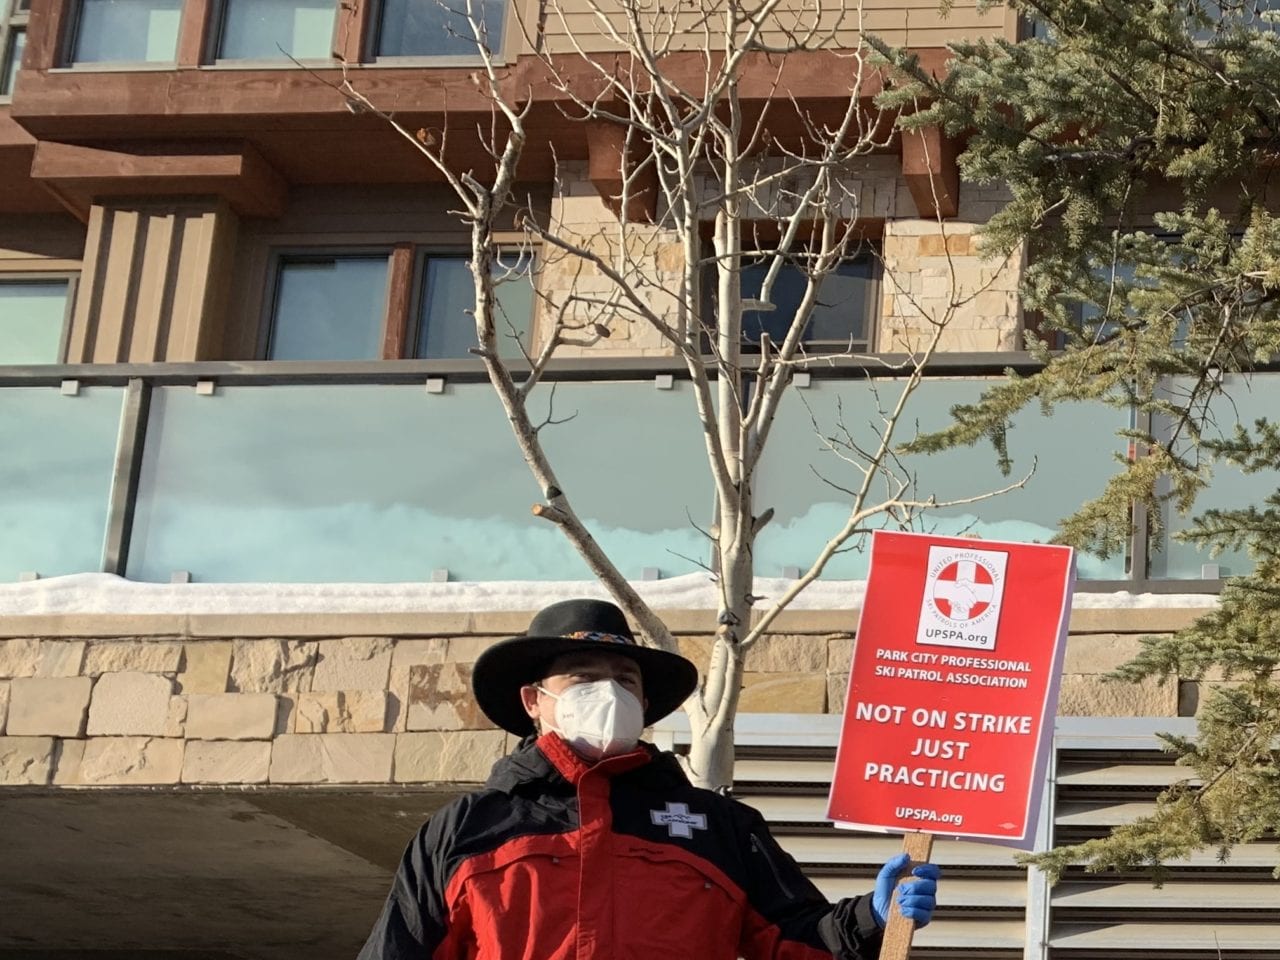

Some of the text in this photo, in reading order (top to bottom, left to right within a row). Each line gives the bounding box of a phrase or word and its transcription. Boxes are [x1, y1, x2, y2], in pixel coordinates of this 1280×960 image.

[930, 552, 1000, 581] UNITED PROFESSIONAL
[932, 610, 957, 628] PATROLS
[971, 604, 997, 626] AMERICA
[925, 629, 988, 645] UPSPA.org
[877, 649, 1031, 671] PARK CITY PROFESSIONAL
[876, 666, 1027, 688] SKI PATROL ASSOCIATION
[856, 702, 1032, 734] NOT ON STRIKE
[911, 739, 969, 759] JUST
[865, 763, 1004, 792] PRACTICING
[896, 807, 962, 825] UPSPA.org
